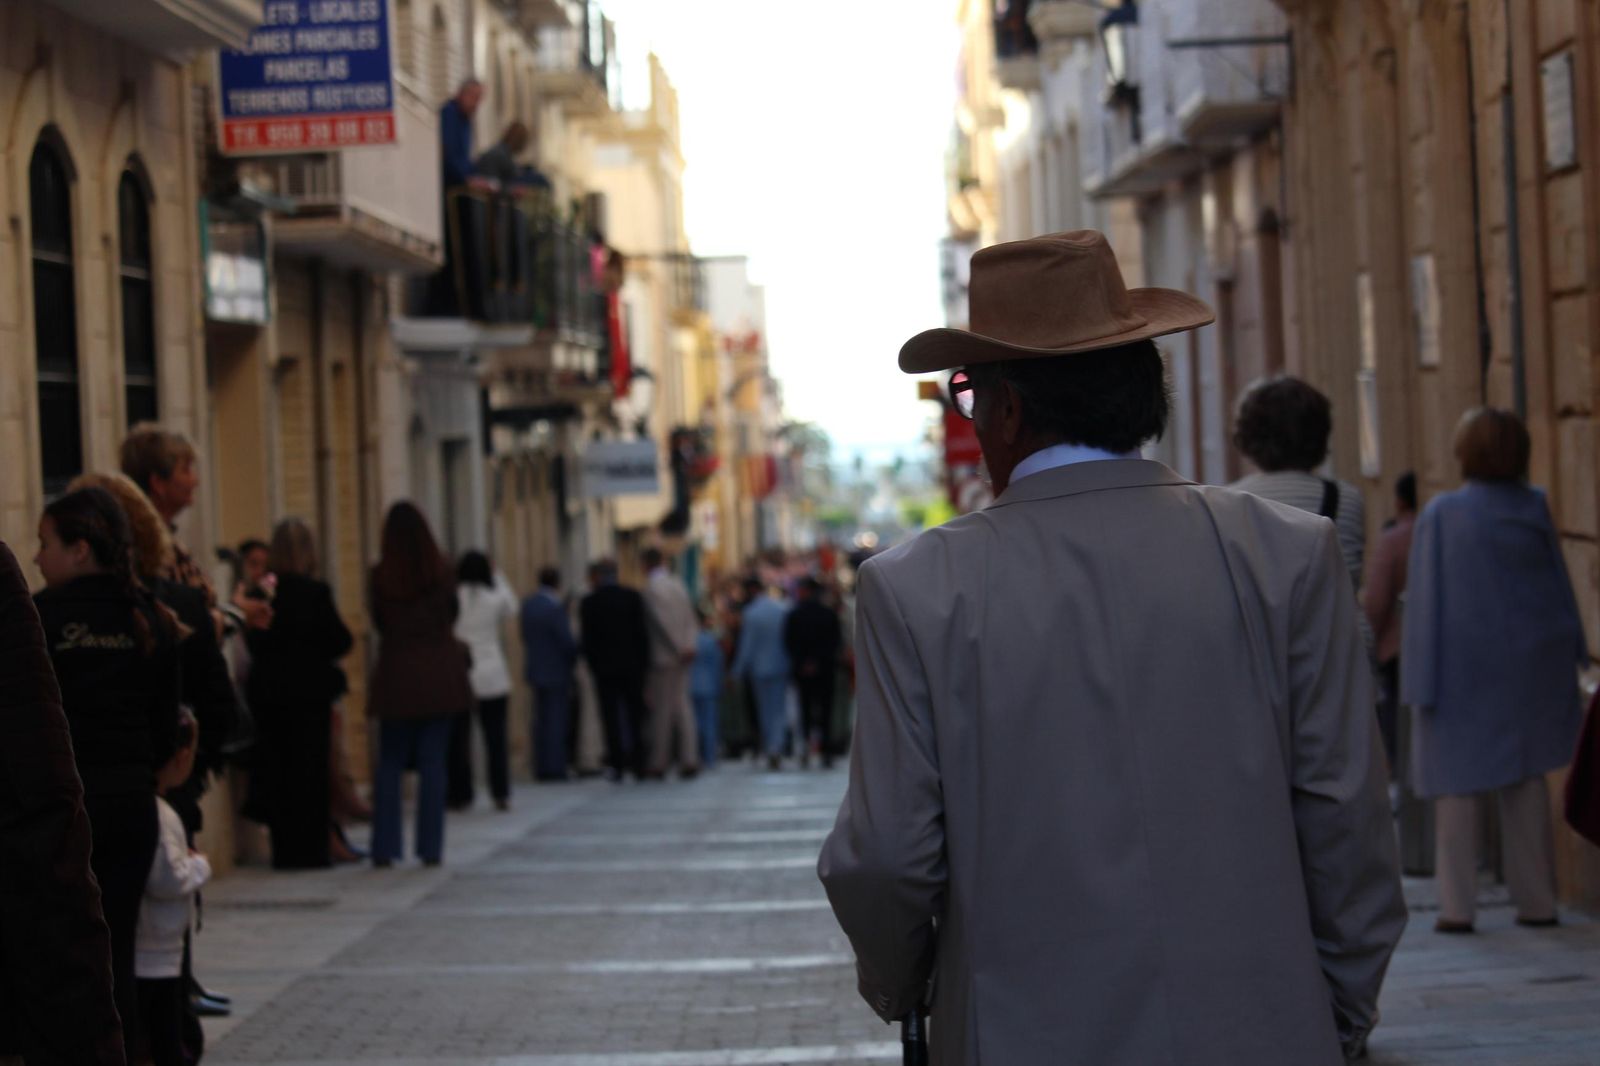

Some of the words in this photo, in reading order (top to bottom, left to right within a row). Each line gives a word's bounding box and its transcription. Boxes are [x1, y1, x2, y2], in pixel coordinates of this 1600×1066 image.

[263, 0, 299, 25] ETS
[309, 0, 380, 23] LOCALES
[295, 25, 379, 52] PARCIALES
[264, 55, 348, 82] PARCELAS
[228, 86, 308, 113] TERRENOS
